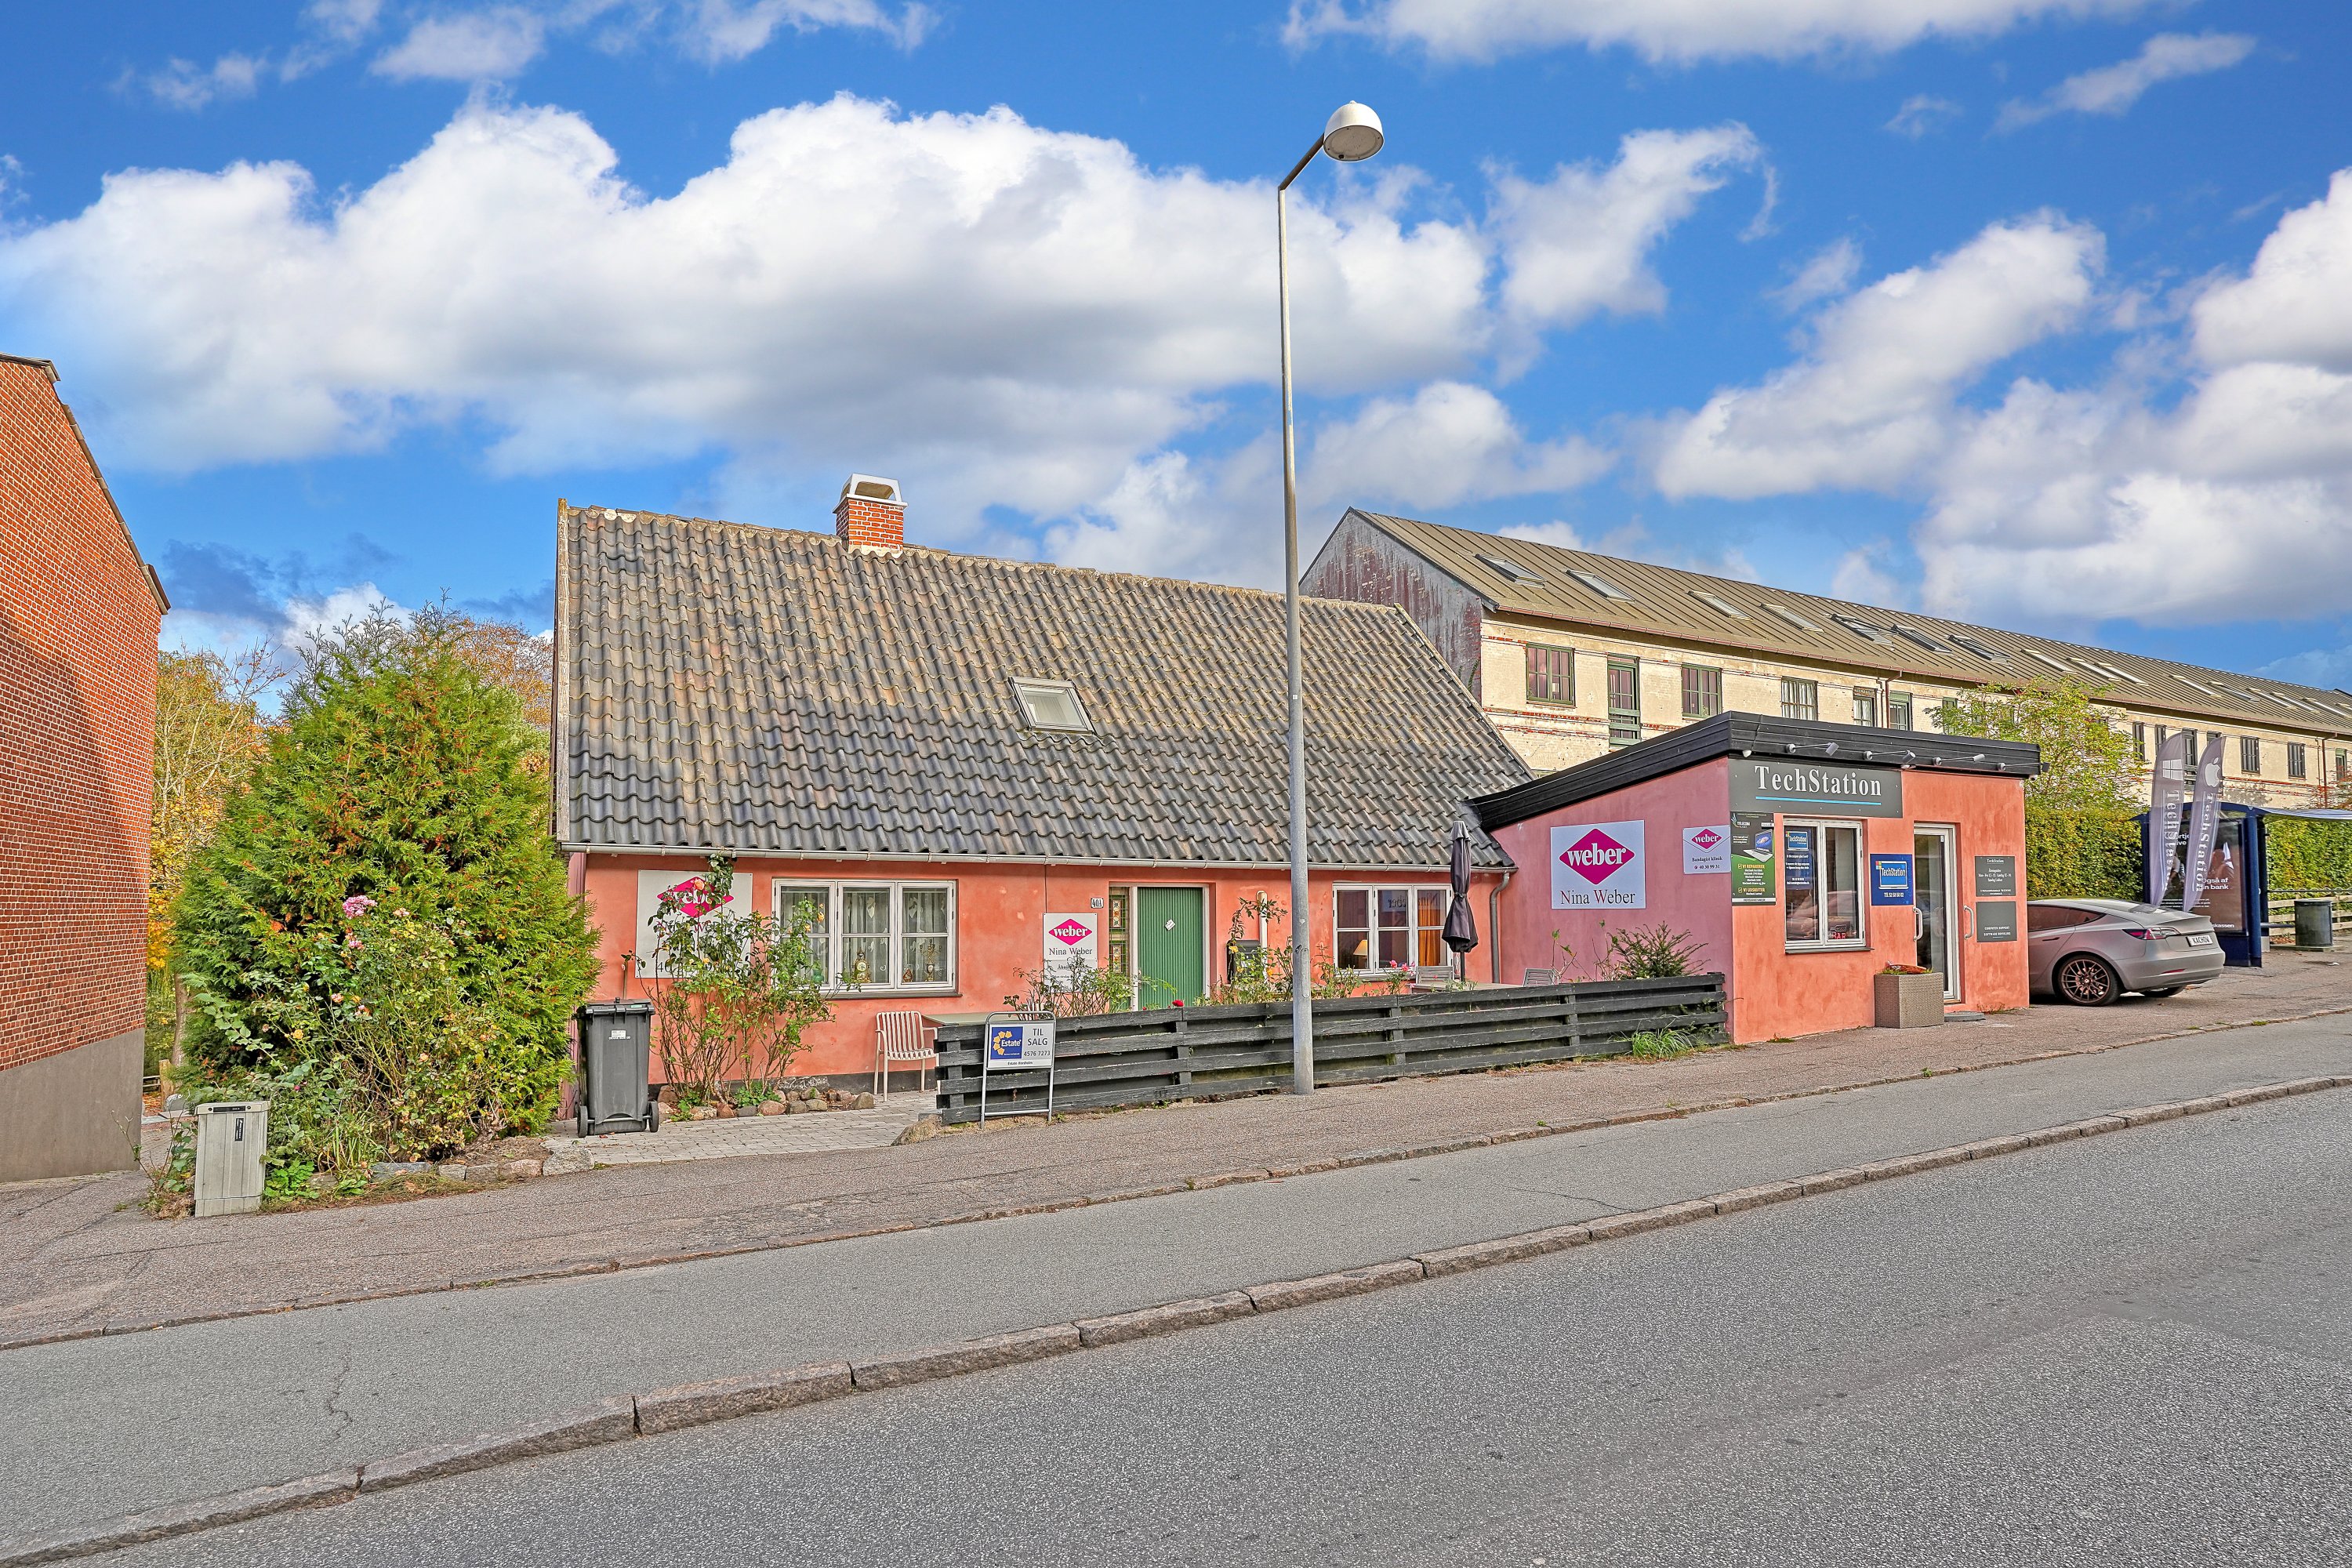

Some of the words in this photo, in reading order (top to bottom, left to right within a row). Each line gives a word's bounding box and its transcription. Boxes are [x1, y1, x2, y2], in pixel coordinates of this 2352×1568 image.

[1755, 765, 1882, 797] TechStation
[1695, 833, 1719, 843] weber
[1566, 842, 1627, 866] weber
[1882, 867, 1906, 877] TechStation
[1560, 890, 1589, 904] Nina
[1593, 889, 1635, 904] Weber
[1053, 925, 1088, 937] weber
[1049, 947, 1067, 956] Nina
[1033, 1028, 1044, 1036] TIL
[1027, 1037, 1048, 1046] SALG
